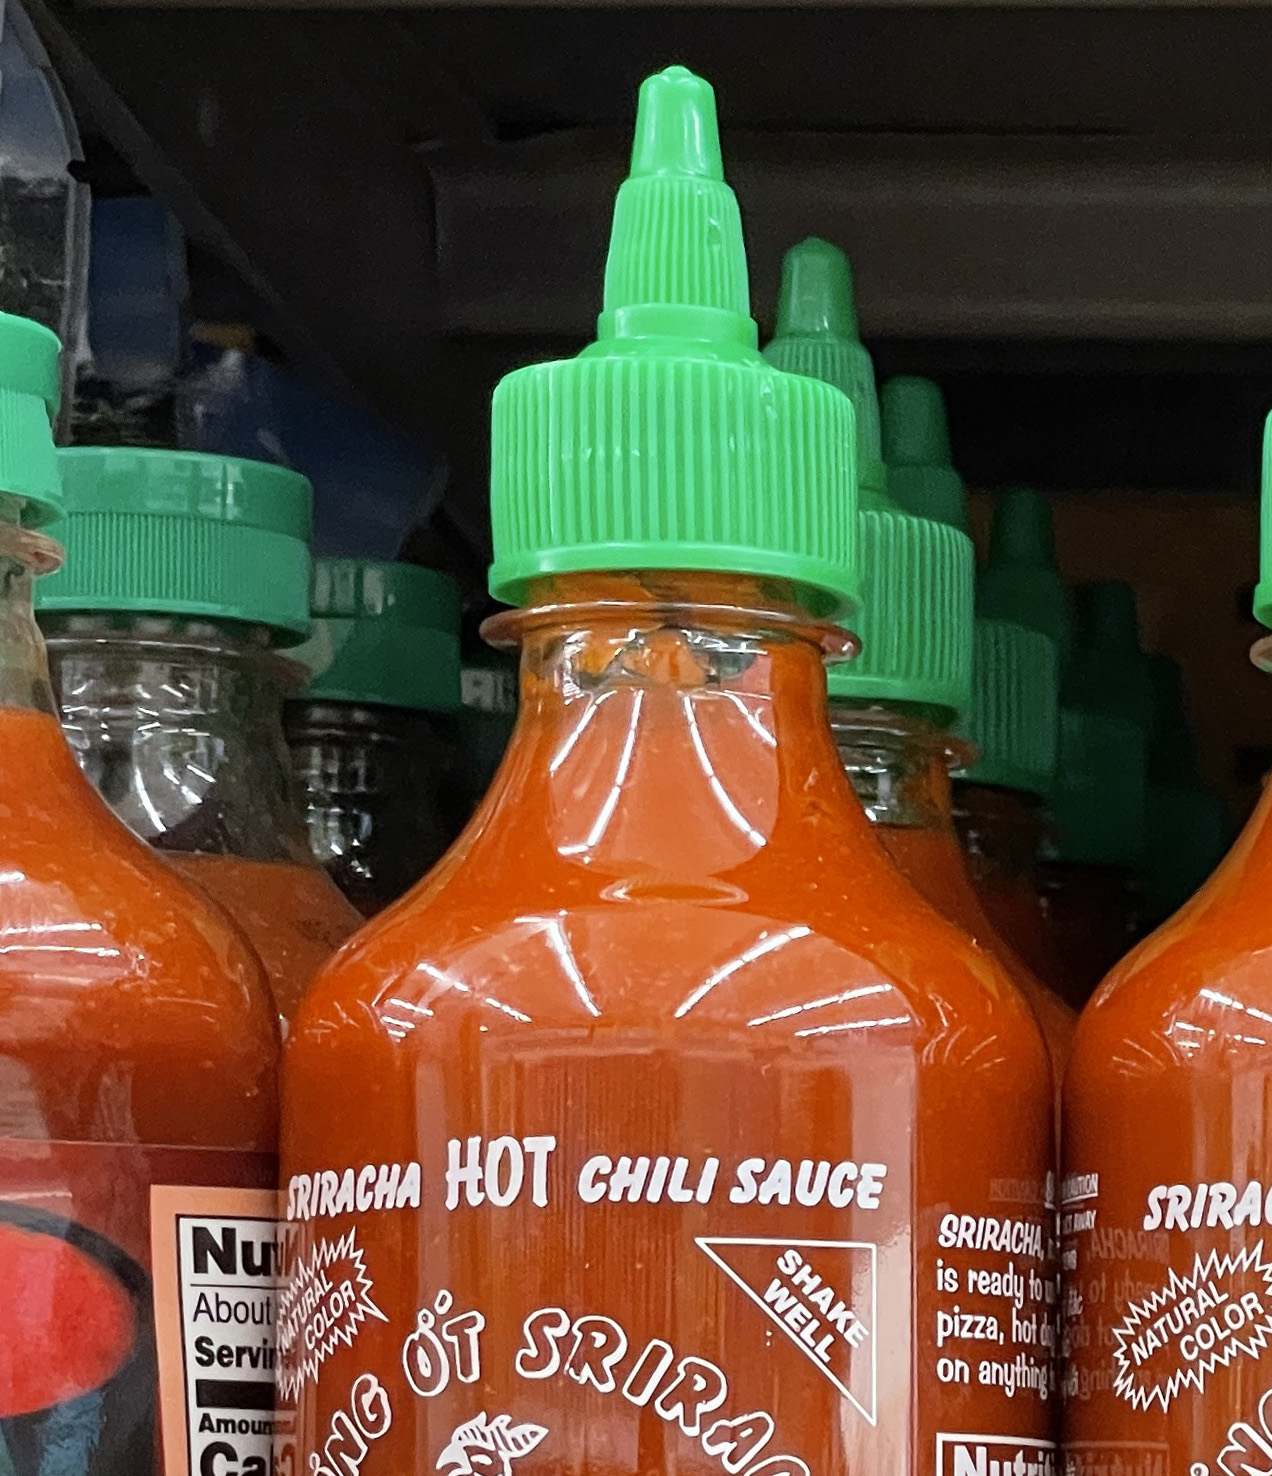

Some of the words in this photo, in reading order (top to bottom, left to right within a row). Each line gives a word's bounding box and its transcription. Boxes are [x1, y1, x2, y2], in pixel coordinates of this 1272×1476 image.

[287, 1161, 421, 1221] SRIRACHA
[446, 1136, 557, 1209] HOT
[578, 1155, 719, 1204] CHILI
[730, 1157, 887, 1210] SAUCE
[193, 1292, 272, 1324] About
[937, 1259, 958, 1293] is
[968, 1261, 1023, 1308] ready
[937, 1305, 1004, 1347] pizza,
[1012, 1308, 1036, 1344] hot
[1130, 1282, 1230, 1367] NATURAL
[1179, 1291, 1264, 1360] COLOR
[979, 1352, 1047, 1399] anything
